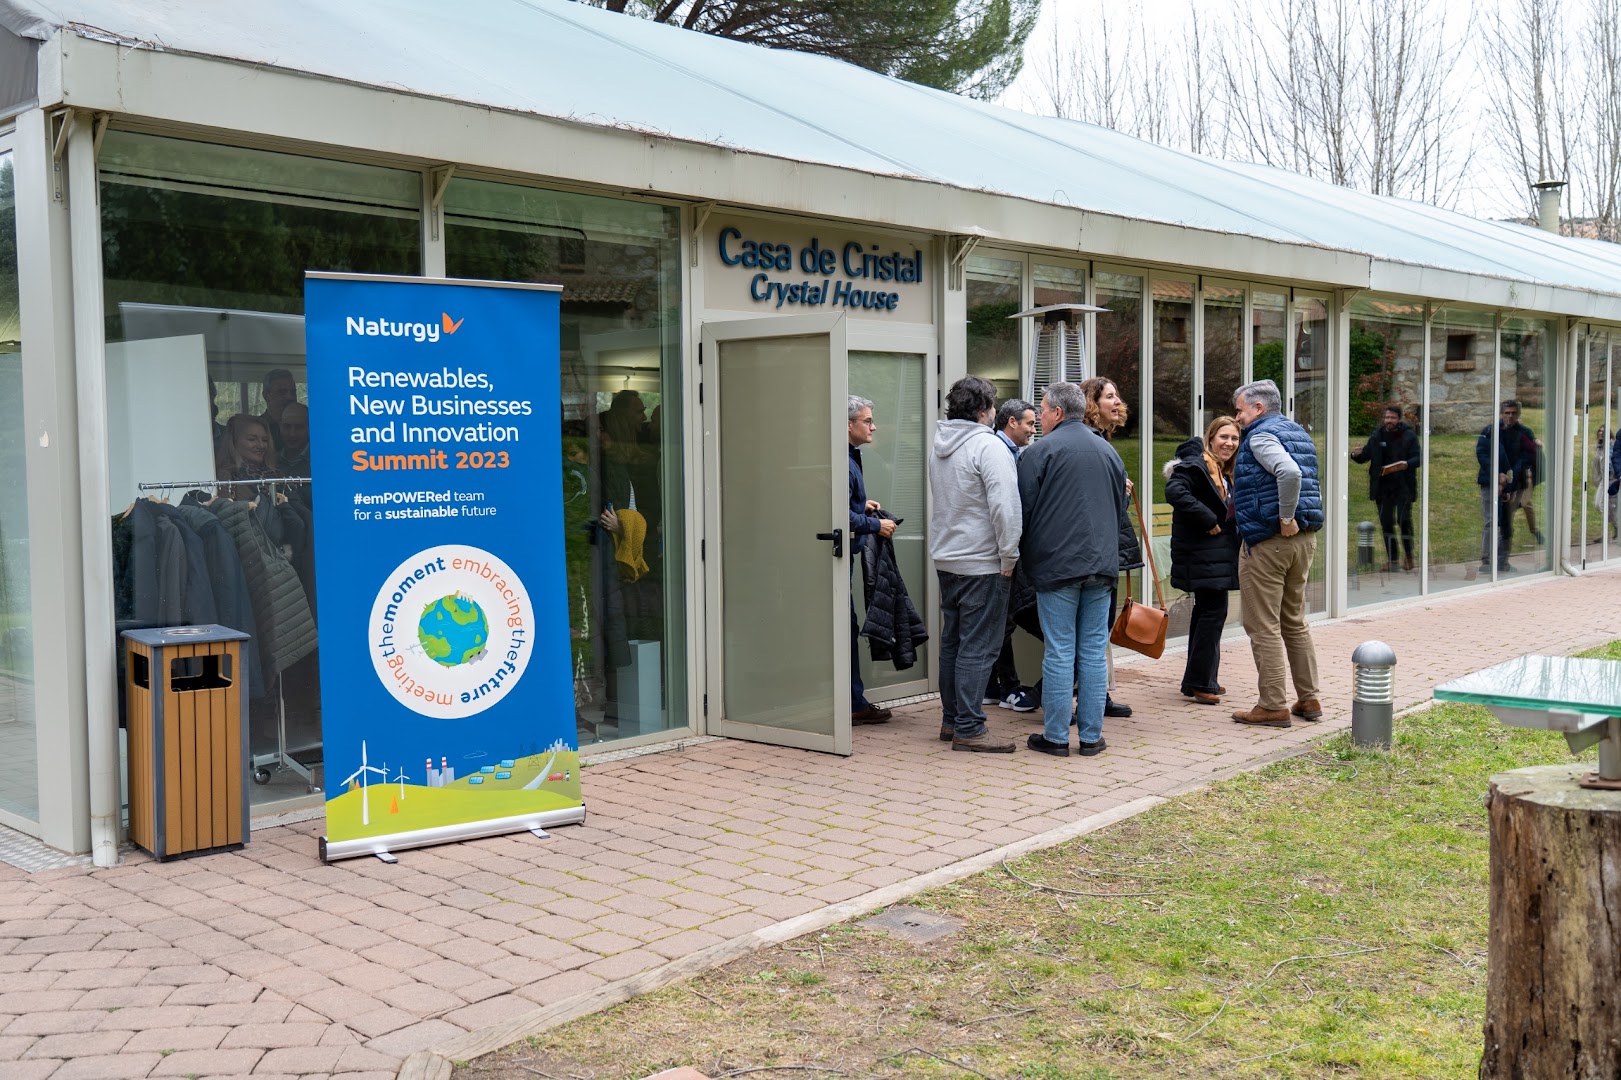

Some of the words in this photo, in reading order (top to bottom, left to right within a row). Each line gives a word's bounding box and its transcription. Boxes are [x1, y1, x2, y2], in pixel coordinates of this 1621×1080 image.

[718, 227, 792, 271] Casa
[800, 238, 836, 275] de
[843, 241, 923, 283] Cristal
[751, 273, 830, 309] Crystal
[832, 280, 899, 310] House
[346, 316, 440, 343] Naturgy
[348, 366, 494, 393] Renewables,
[350, 394, 405, 416] New
[411, 395, 532, 416] Businesses
[350, 421, 395, 443] and
[402, 422, 519, 443] Innovation
[351, 449, 449, 472] Summit
[455, 451, 510, 470] 2023
[353, 490, 451, 505] #emPOWERed
[453, 492, 485, 502] team
[353, 509, 372, 521] for
[374, 511, 383, 520] a
[385, 506, 459, 519] sustainable
[461, 505, 497, 517] future
